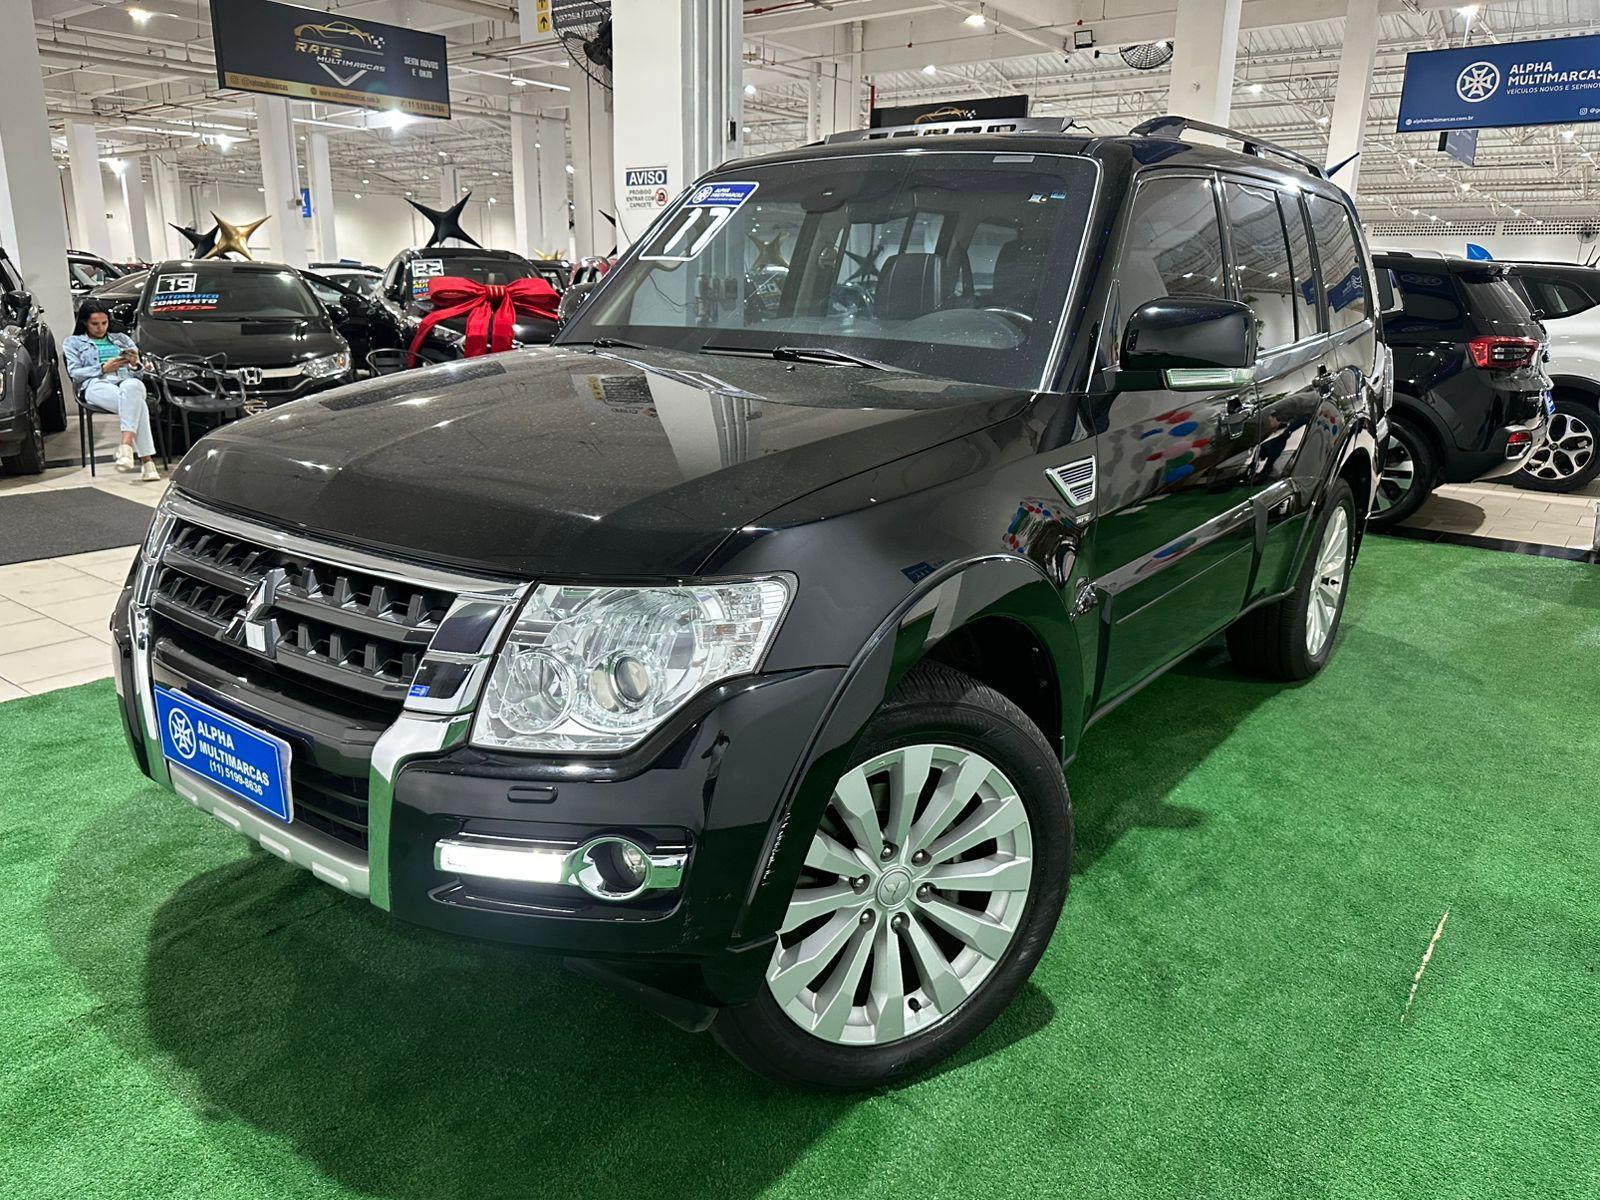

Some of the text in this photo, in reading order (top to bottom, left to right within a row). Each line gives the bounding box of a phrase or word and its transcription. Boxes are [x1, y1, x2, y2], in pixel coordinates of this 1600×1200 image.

[295, 41, 342, 58] RATS
[316, 55, 386, 73] MULTIMARCAS
[1509, 61, 1553, 75] ALPHA
[1539, 85, 1564, 93] NOVOS
[629, 171, 665, 185] AVISO
[663, 207, 731, 256] 17
[150, 298, 218, 307] COMPLETO
[197, 720, 235, 750] ALPHA
[199, 740, 270, 787] MULTIMARCAS
[209, 759, 225, 777] (11)
